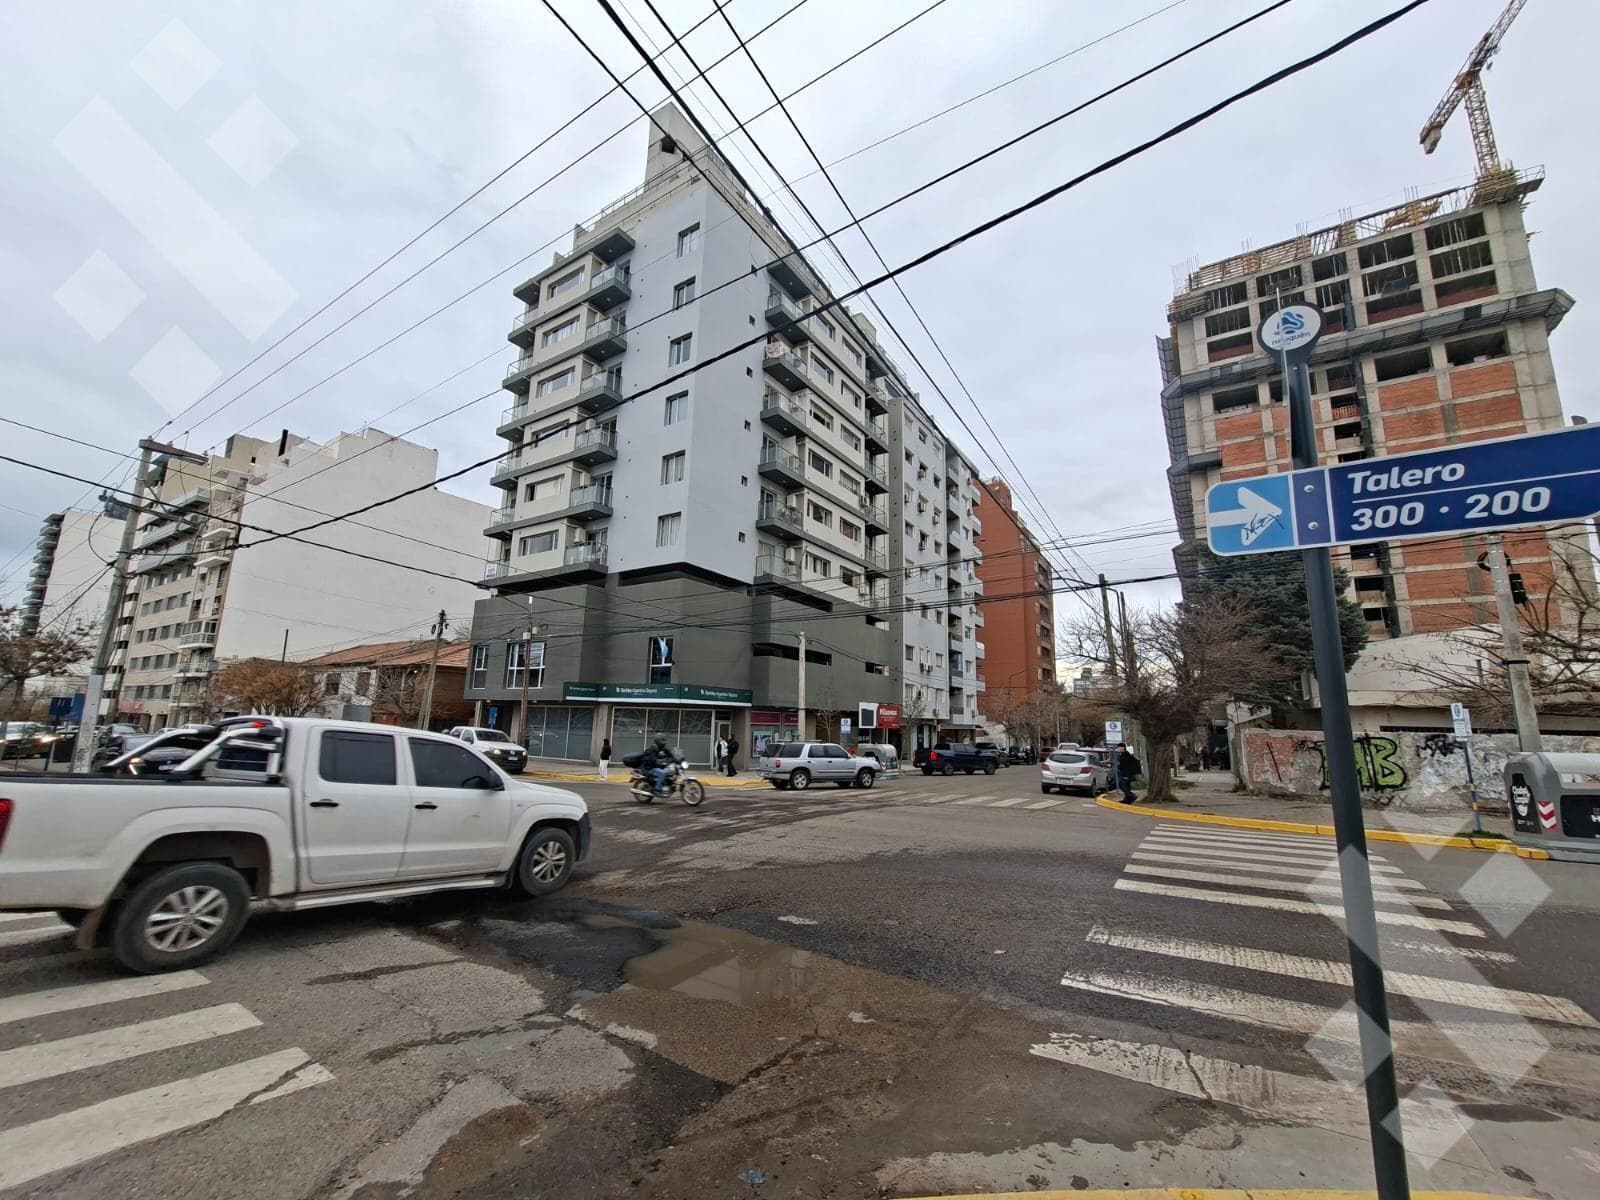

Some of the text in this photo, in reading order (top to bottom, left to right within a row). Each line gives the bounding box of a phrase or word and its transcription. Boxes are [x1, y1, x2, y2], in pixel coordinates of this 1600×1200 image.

[1347, 463, 1466, 494] Talero
[1350, 501, 1425, 531] 300
[1463, 486, 1551, 519] 200
